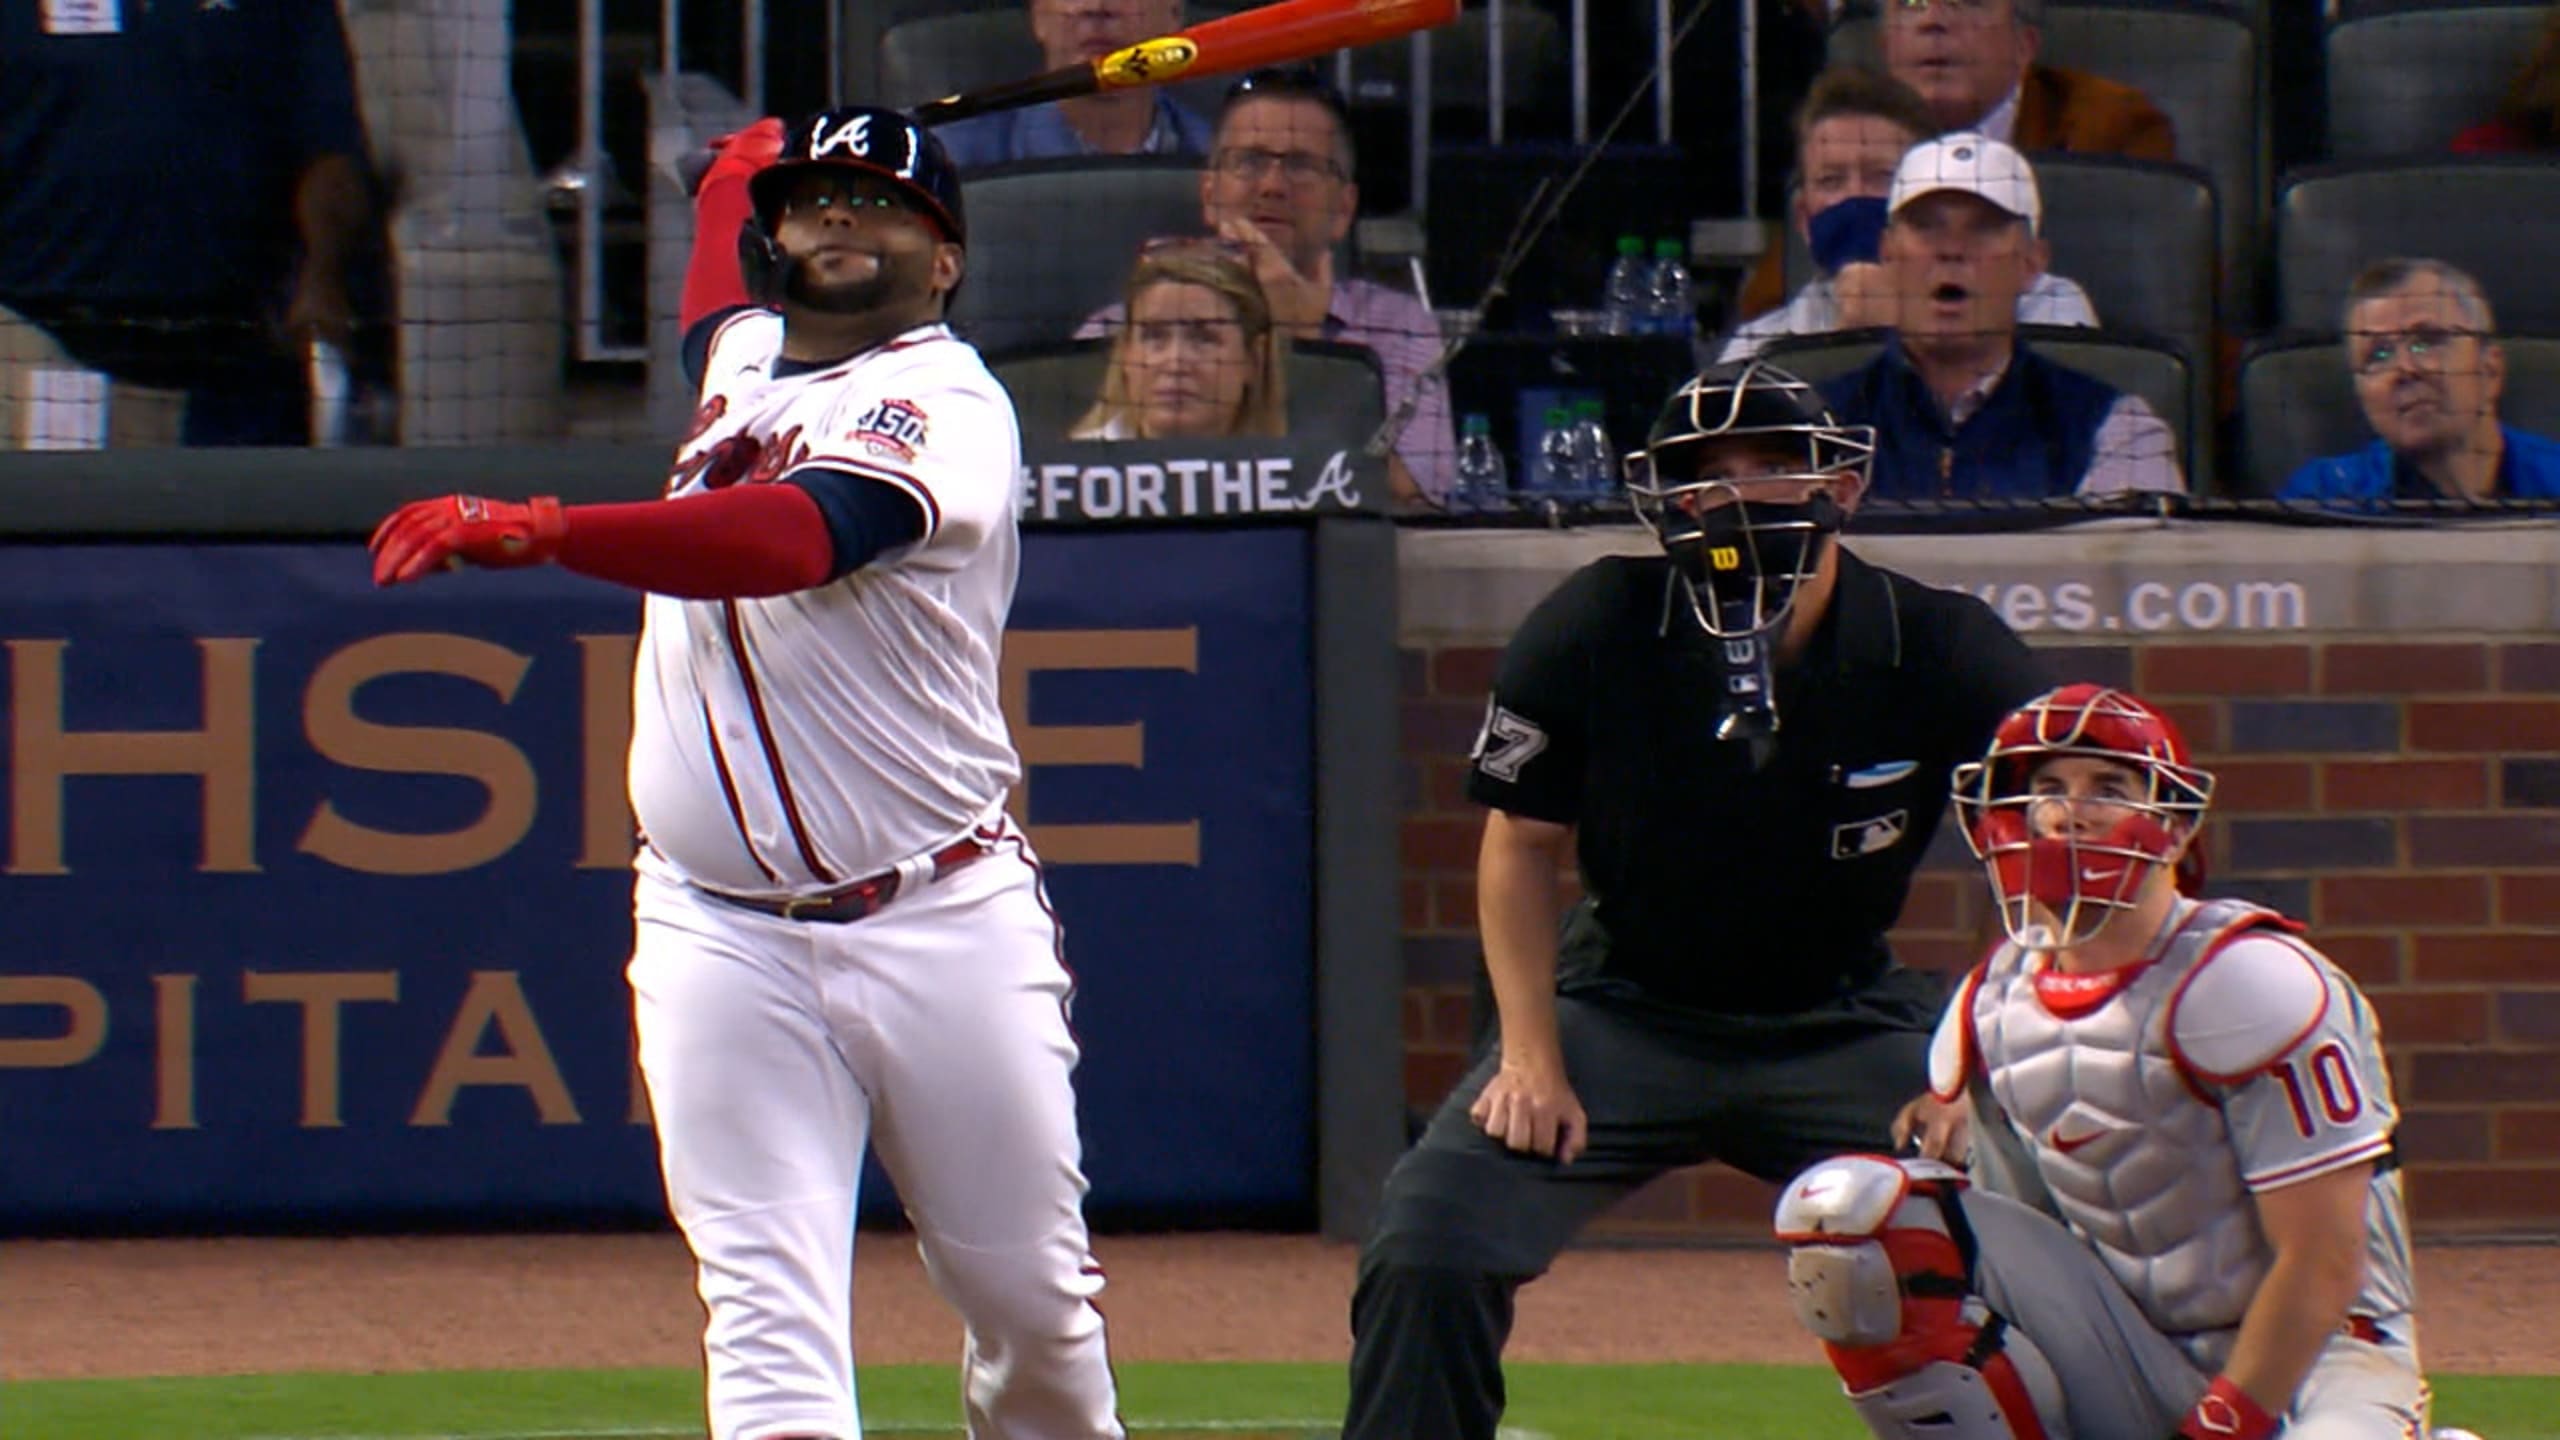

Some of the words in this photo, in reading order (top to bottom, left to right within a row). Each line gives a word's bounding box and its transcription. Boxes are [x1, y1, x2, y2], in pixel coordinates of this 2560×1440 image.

[3, 630, 1200, 876] HSIE
[0, 969, 656, 1128] PITA
[2266, 1042, 2362, 1138] 10
